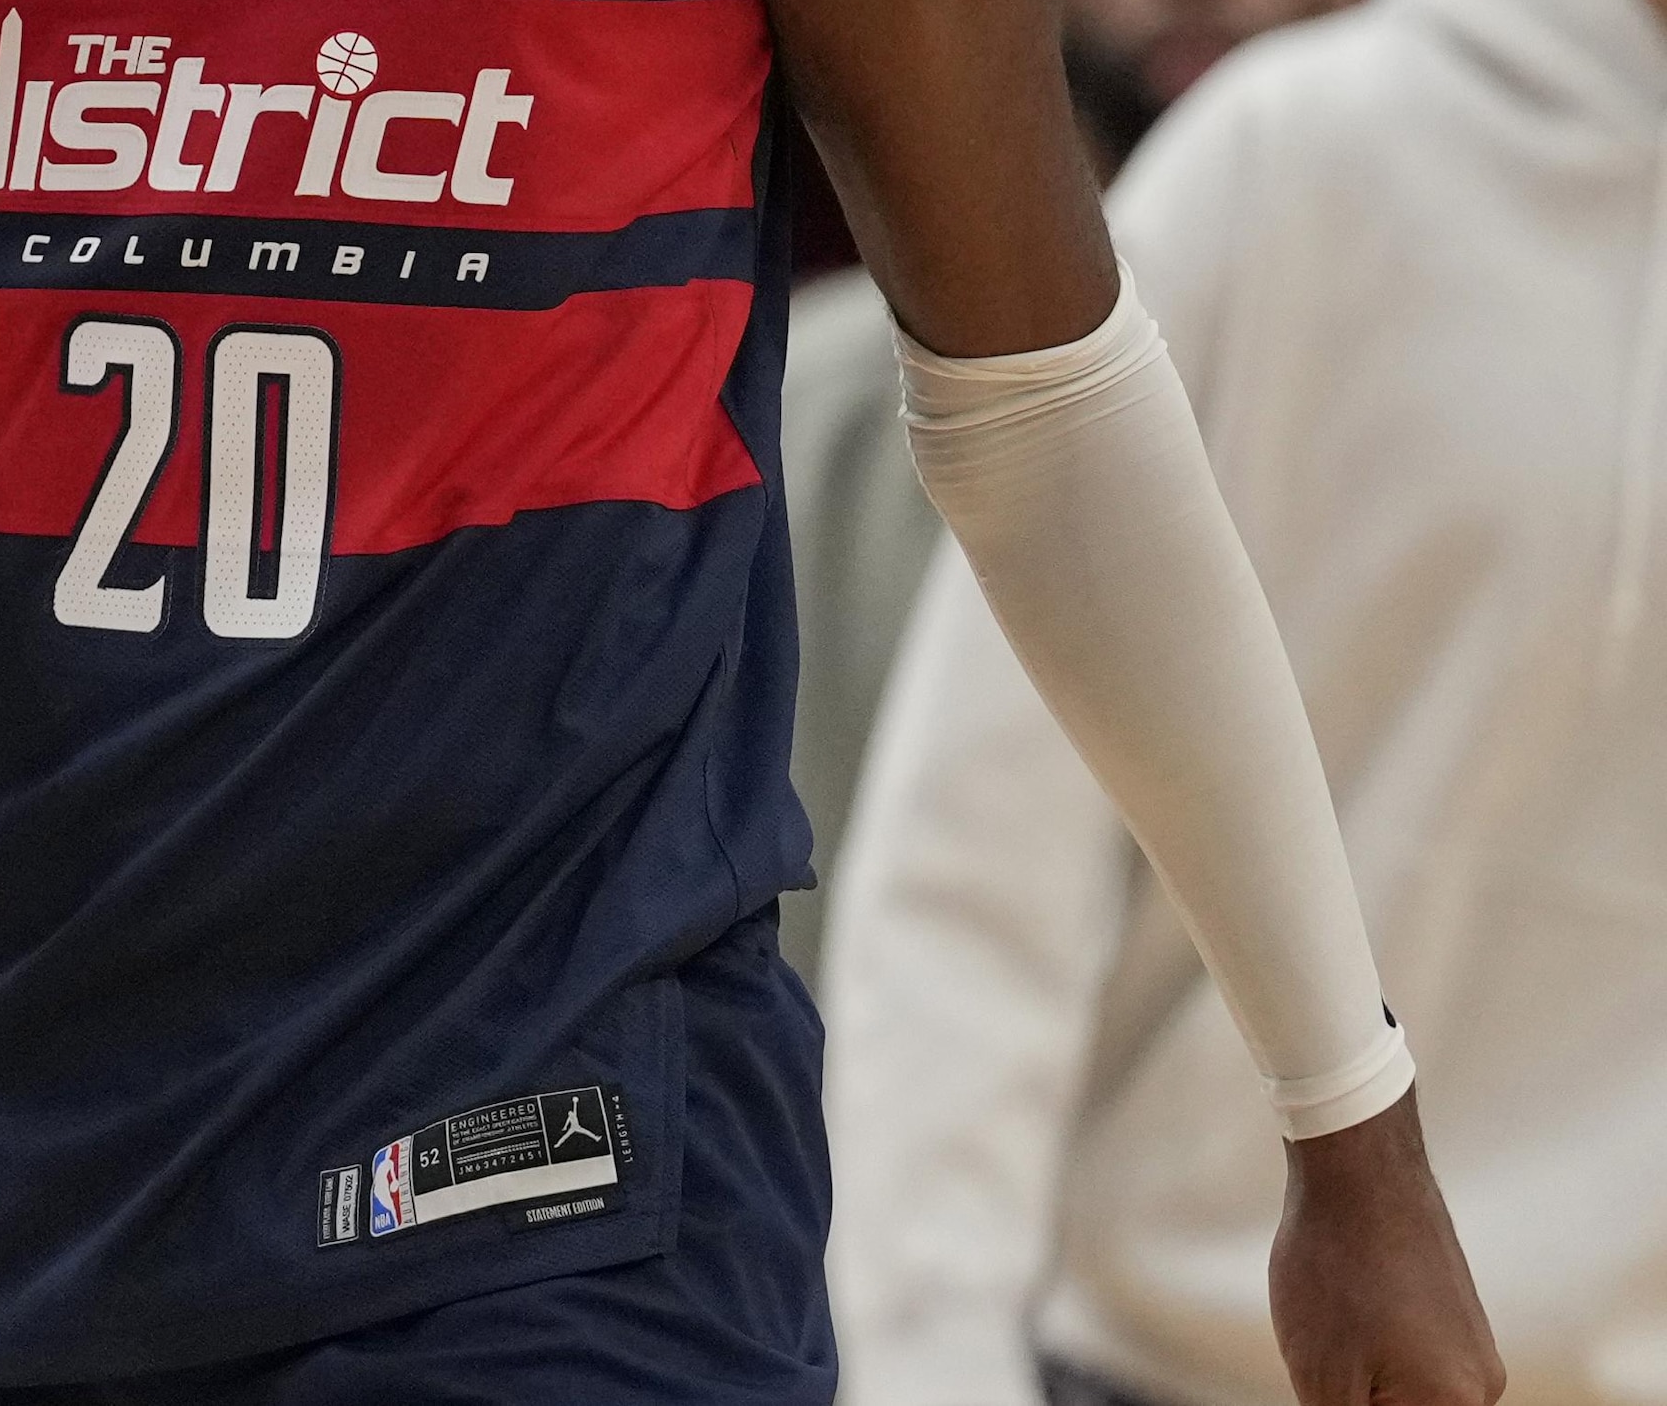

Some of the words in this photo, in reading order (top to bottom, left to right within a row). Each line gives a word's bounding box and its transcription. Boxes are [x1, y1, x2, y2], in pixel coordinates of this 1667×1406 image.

[68, 34, 172, 75] THE
[21, 234, 490, 282] COLUMBIA
[54, 316, 339, 640] 20
[451, 1103, 536, 1132] ENGINEERED
[420, 1148, 440, 1168] 52
[374, 1212, 391, 1229] NBA
[526, 1202, 572, 1223] STATEMENT
[573, 1197, 605, 1215] EDITION
